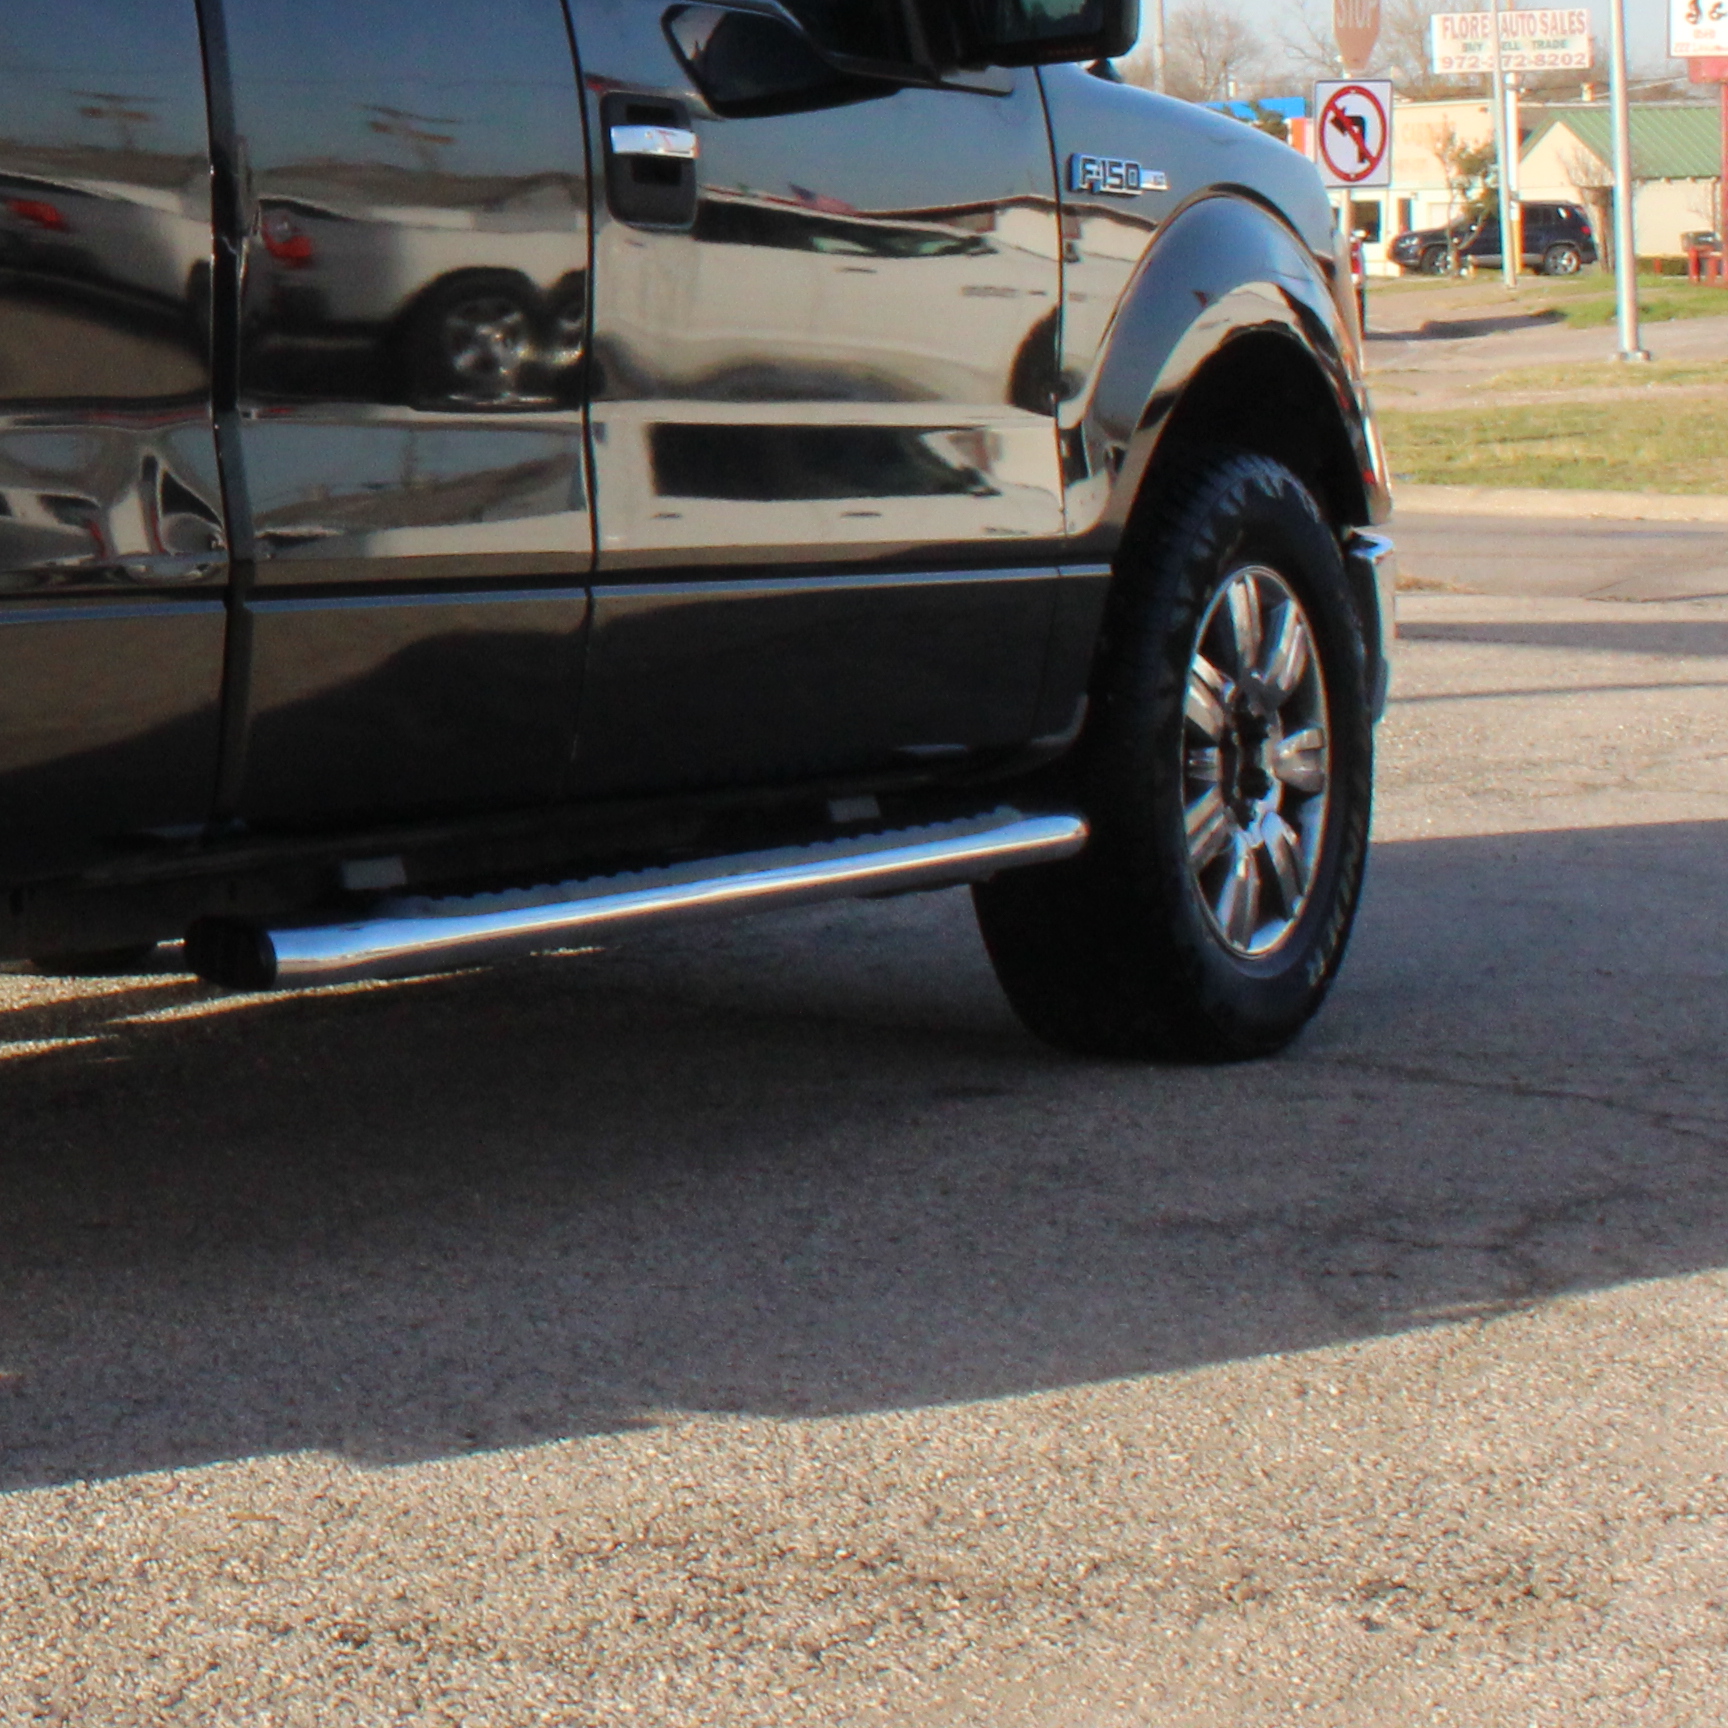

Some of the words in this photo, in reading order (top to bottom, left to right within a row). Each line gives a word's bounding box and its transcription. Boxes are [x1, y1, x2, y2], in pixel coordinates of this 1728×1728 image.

[1442, 15, 1490, 40] FLORE
[1500, 13, 1537, 38] AUTO
[1540, 11, 1587, 35] SALES
[1531, 39, 1568, 50] TRADE
